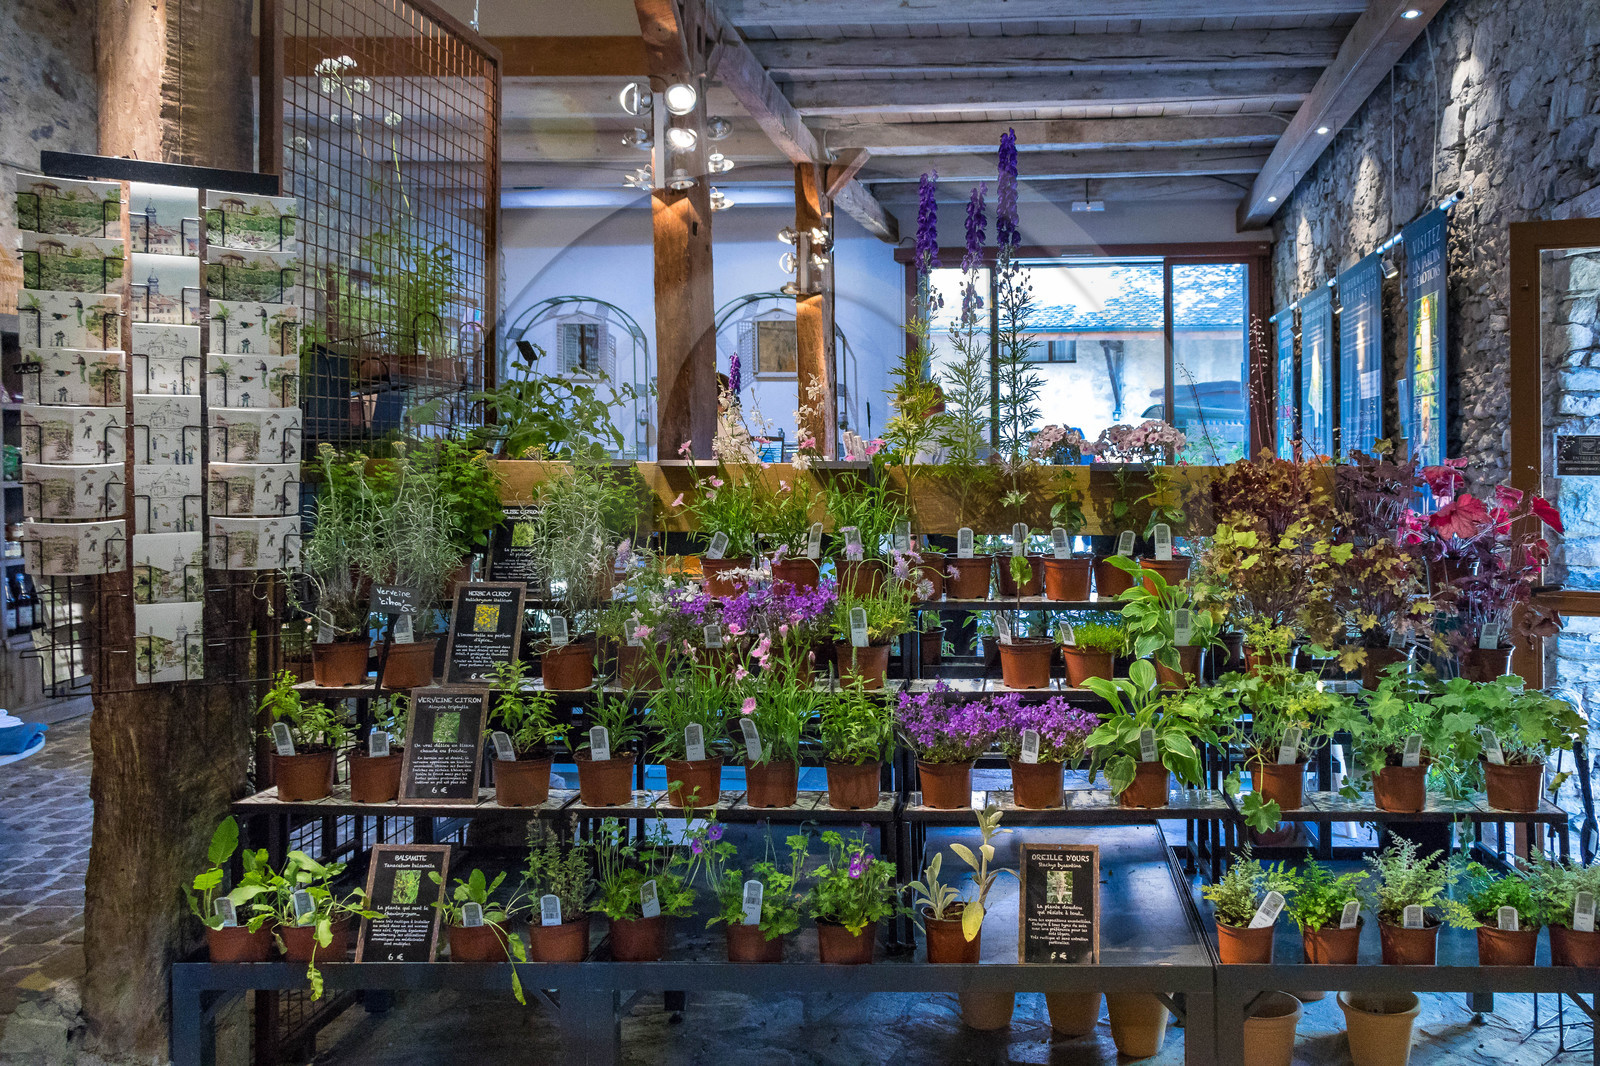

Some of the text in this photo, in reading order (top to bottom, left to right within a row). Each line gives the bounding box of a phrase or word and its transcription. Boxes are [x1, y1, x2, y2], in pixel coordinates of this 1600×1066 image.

[1412, 224, 1440, 256] VISITEZ
[1343, 276, 1377, 306] PRATIQUES
[376, 587, 411, 598] Verveine
